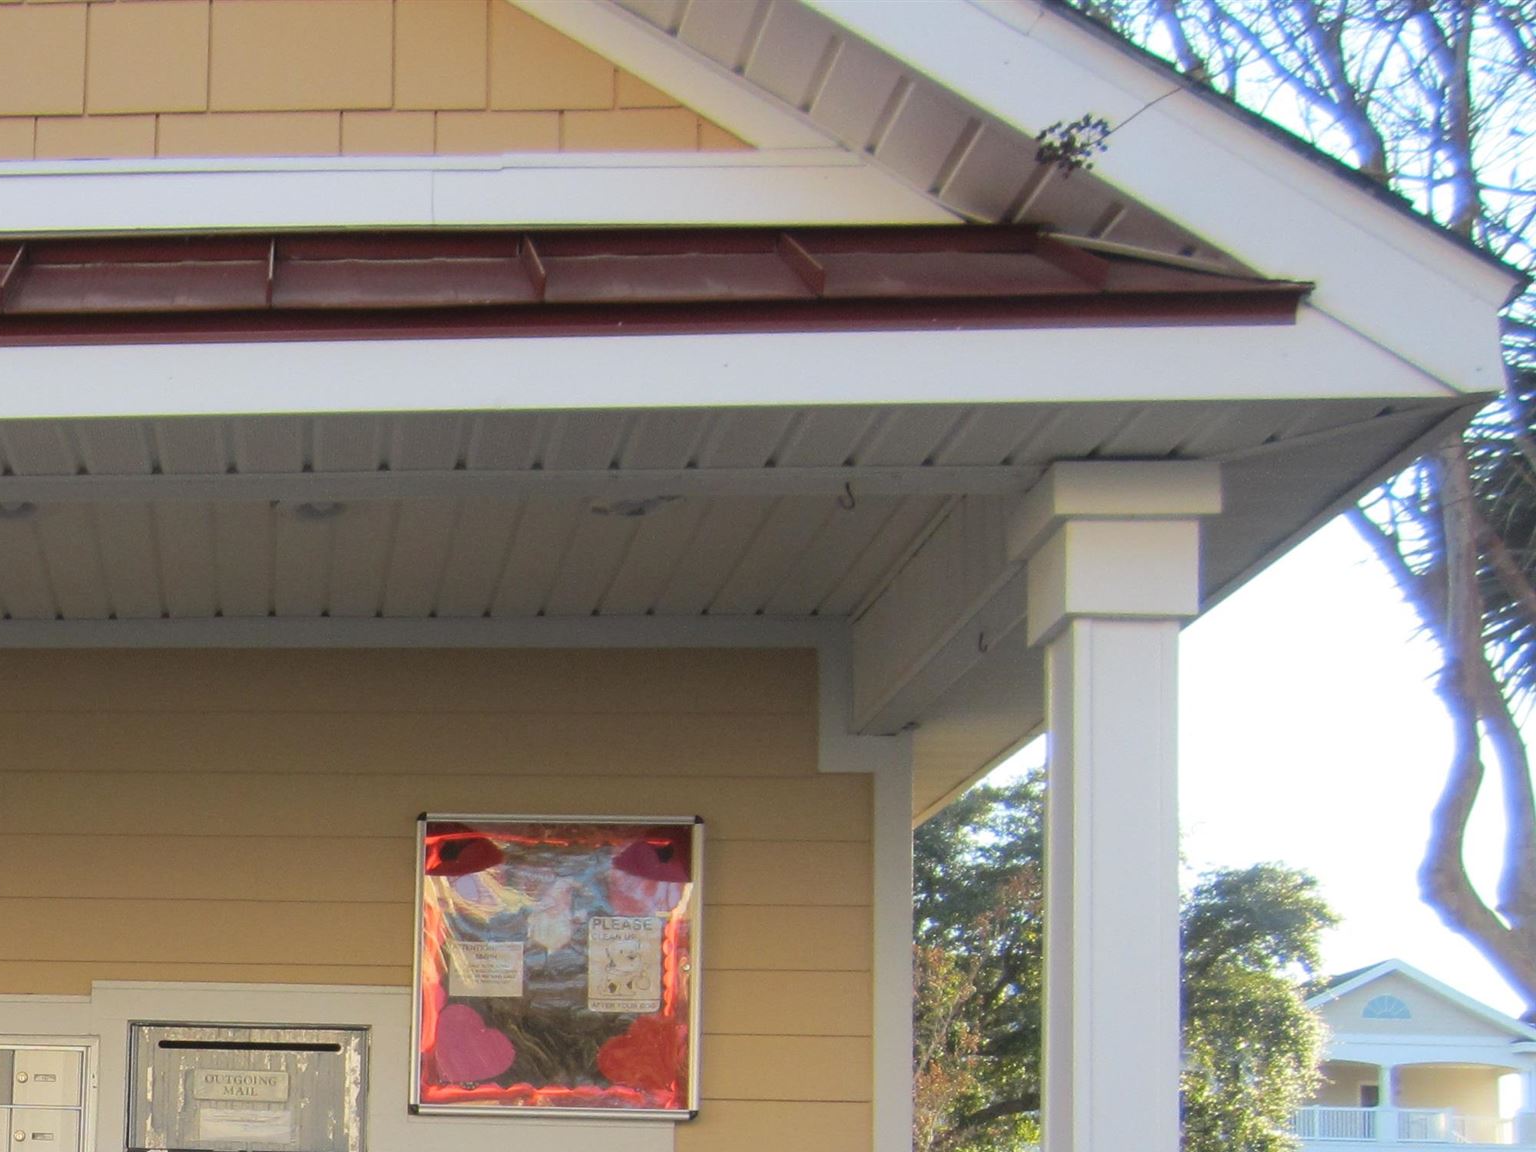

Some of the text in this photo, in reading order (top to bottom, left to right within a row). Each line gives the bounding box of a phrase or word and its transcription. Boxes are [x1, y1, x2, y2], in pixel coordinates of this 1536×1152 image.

[592, 918, 652, 931] PLEASE
[205, 1075, 277, 1086] OUTGOING
[224, 1086, 258, 1096] MAIL
